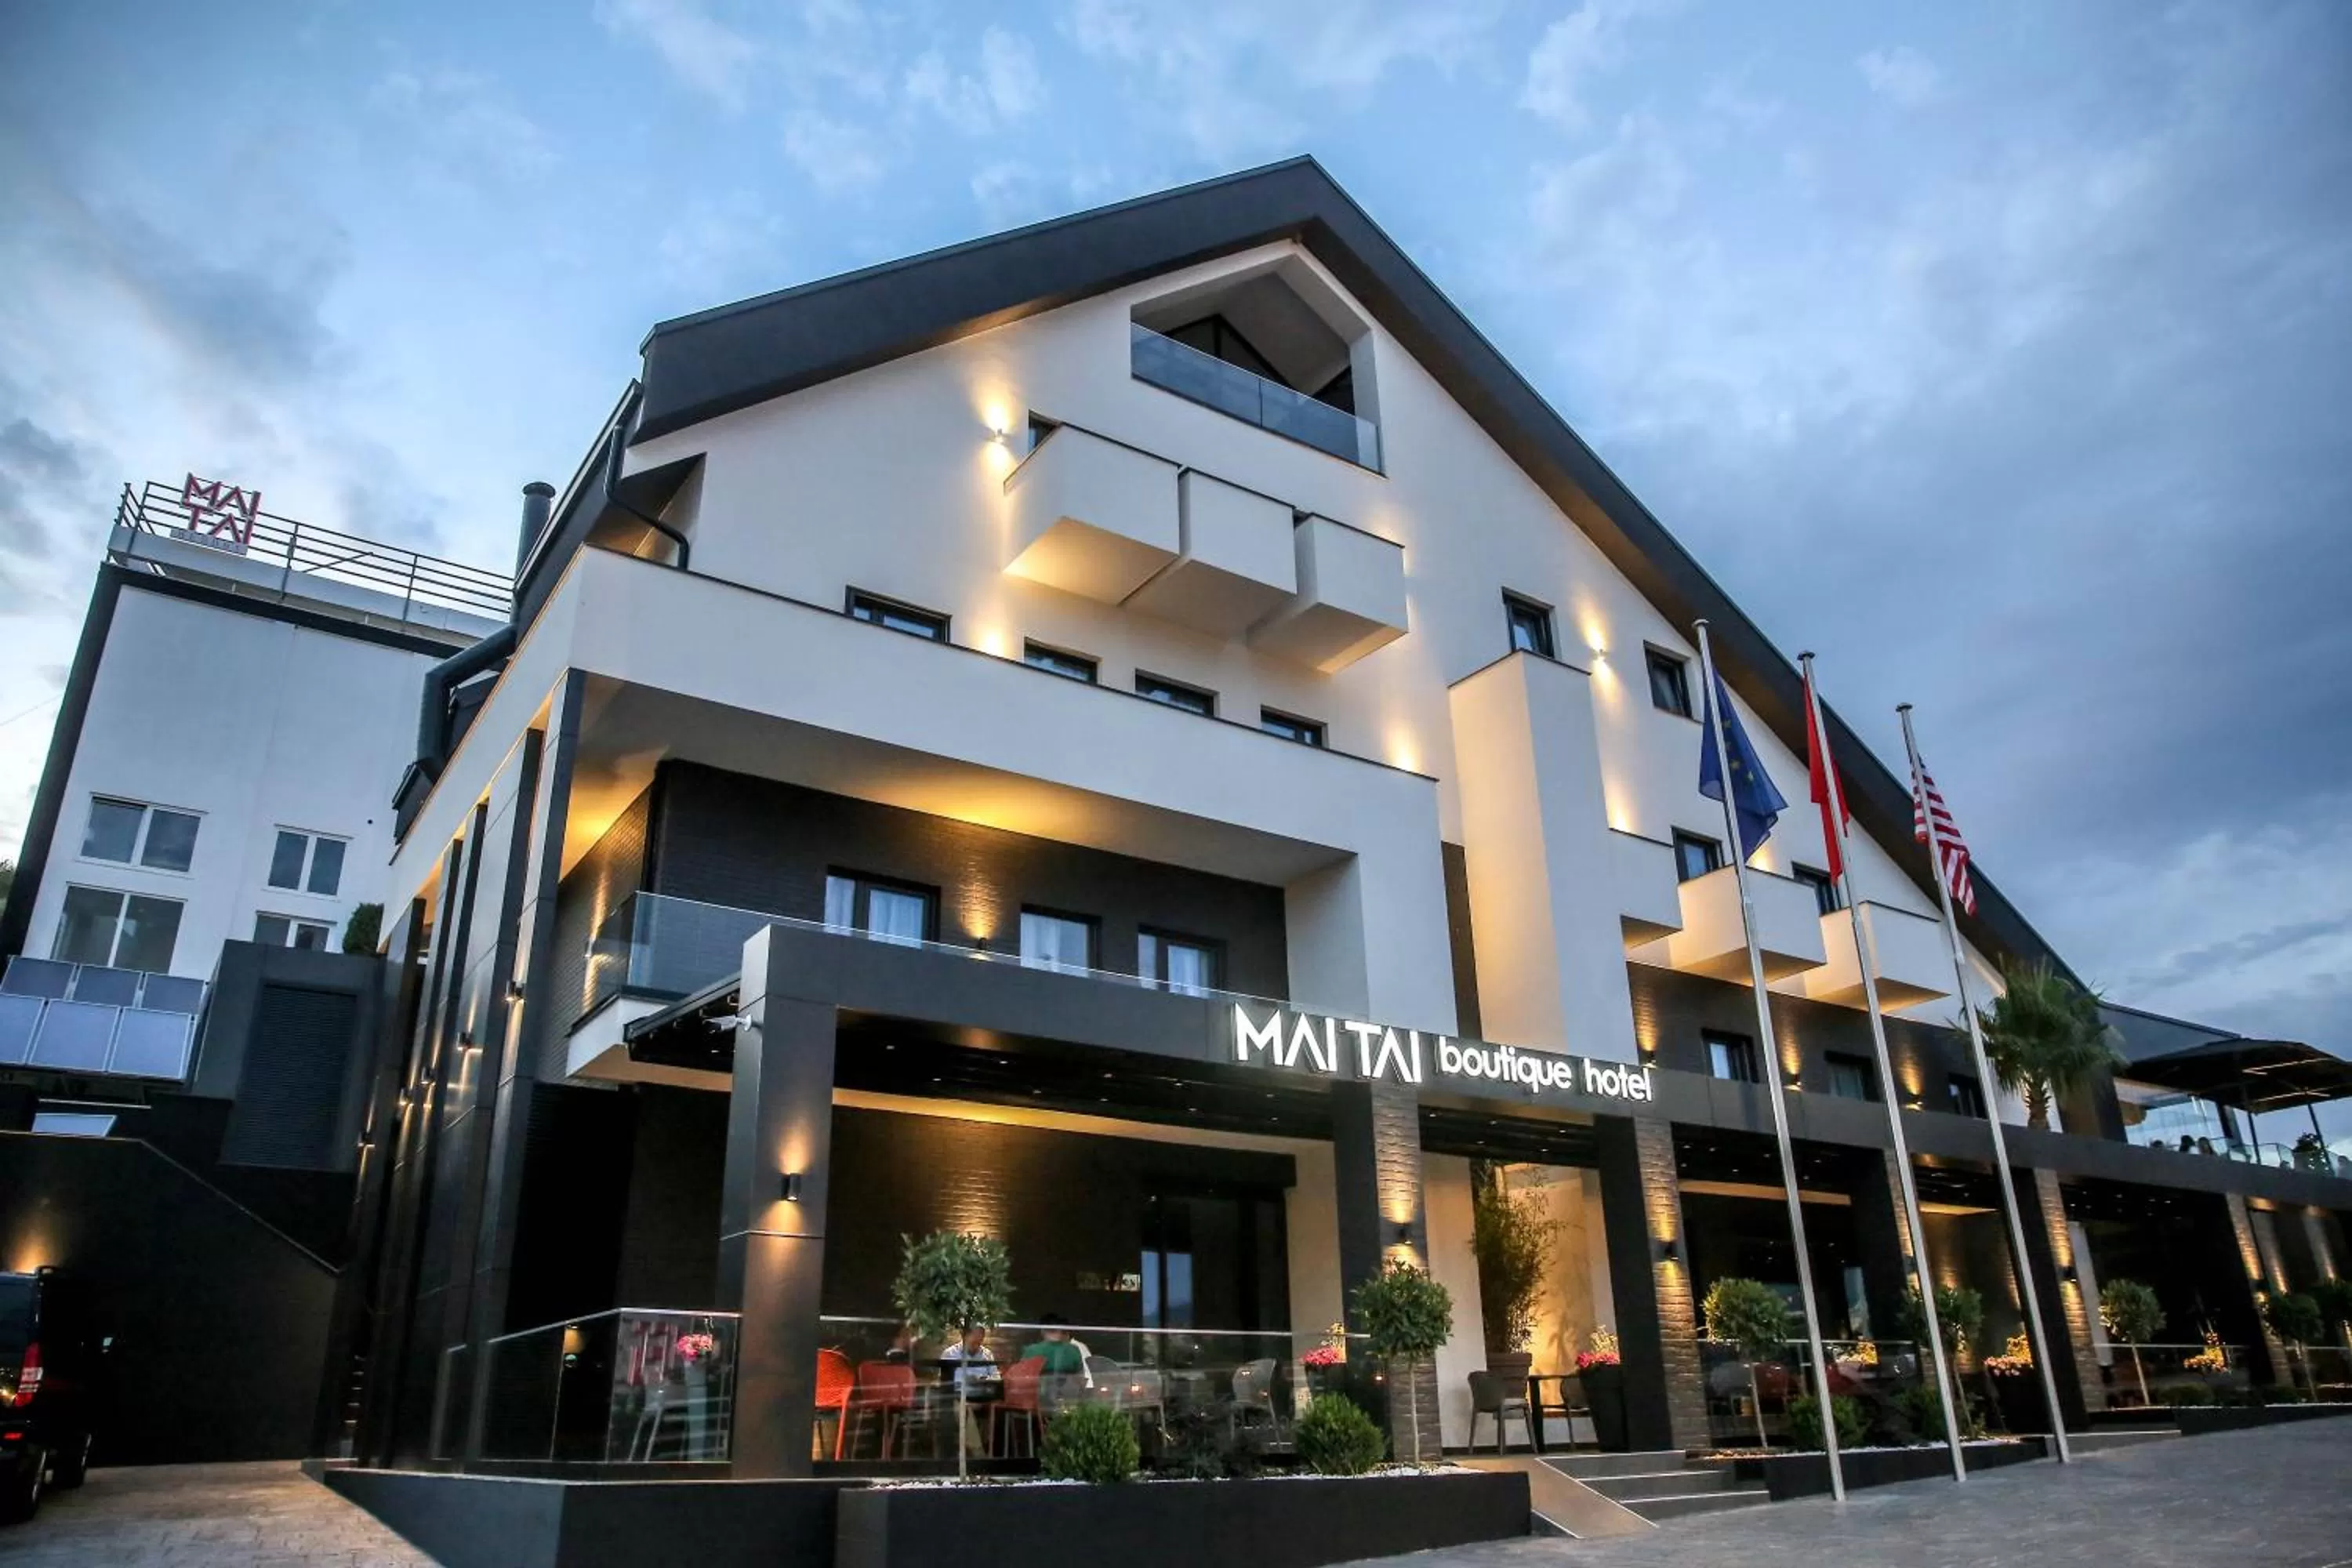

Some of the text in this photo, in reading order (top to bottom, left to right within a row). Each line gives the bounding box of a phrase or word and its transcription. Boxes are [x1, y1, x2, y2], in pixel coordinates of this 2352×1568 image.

[182, 472, 261, 517] MAI
[180, 500, 254, 545] TAI
[1235, 1003, 1653, 1102] MAI TAI boutique hotel
